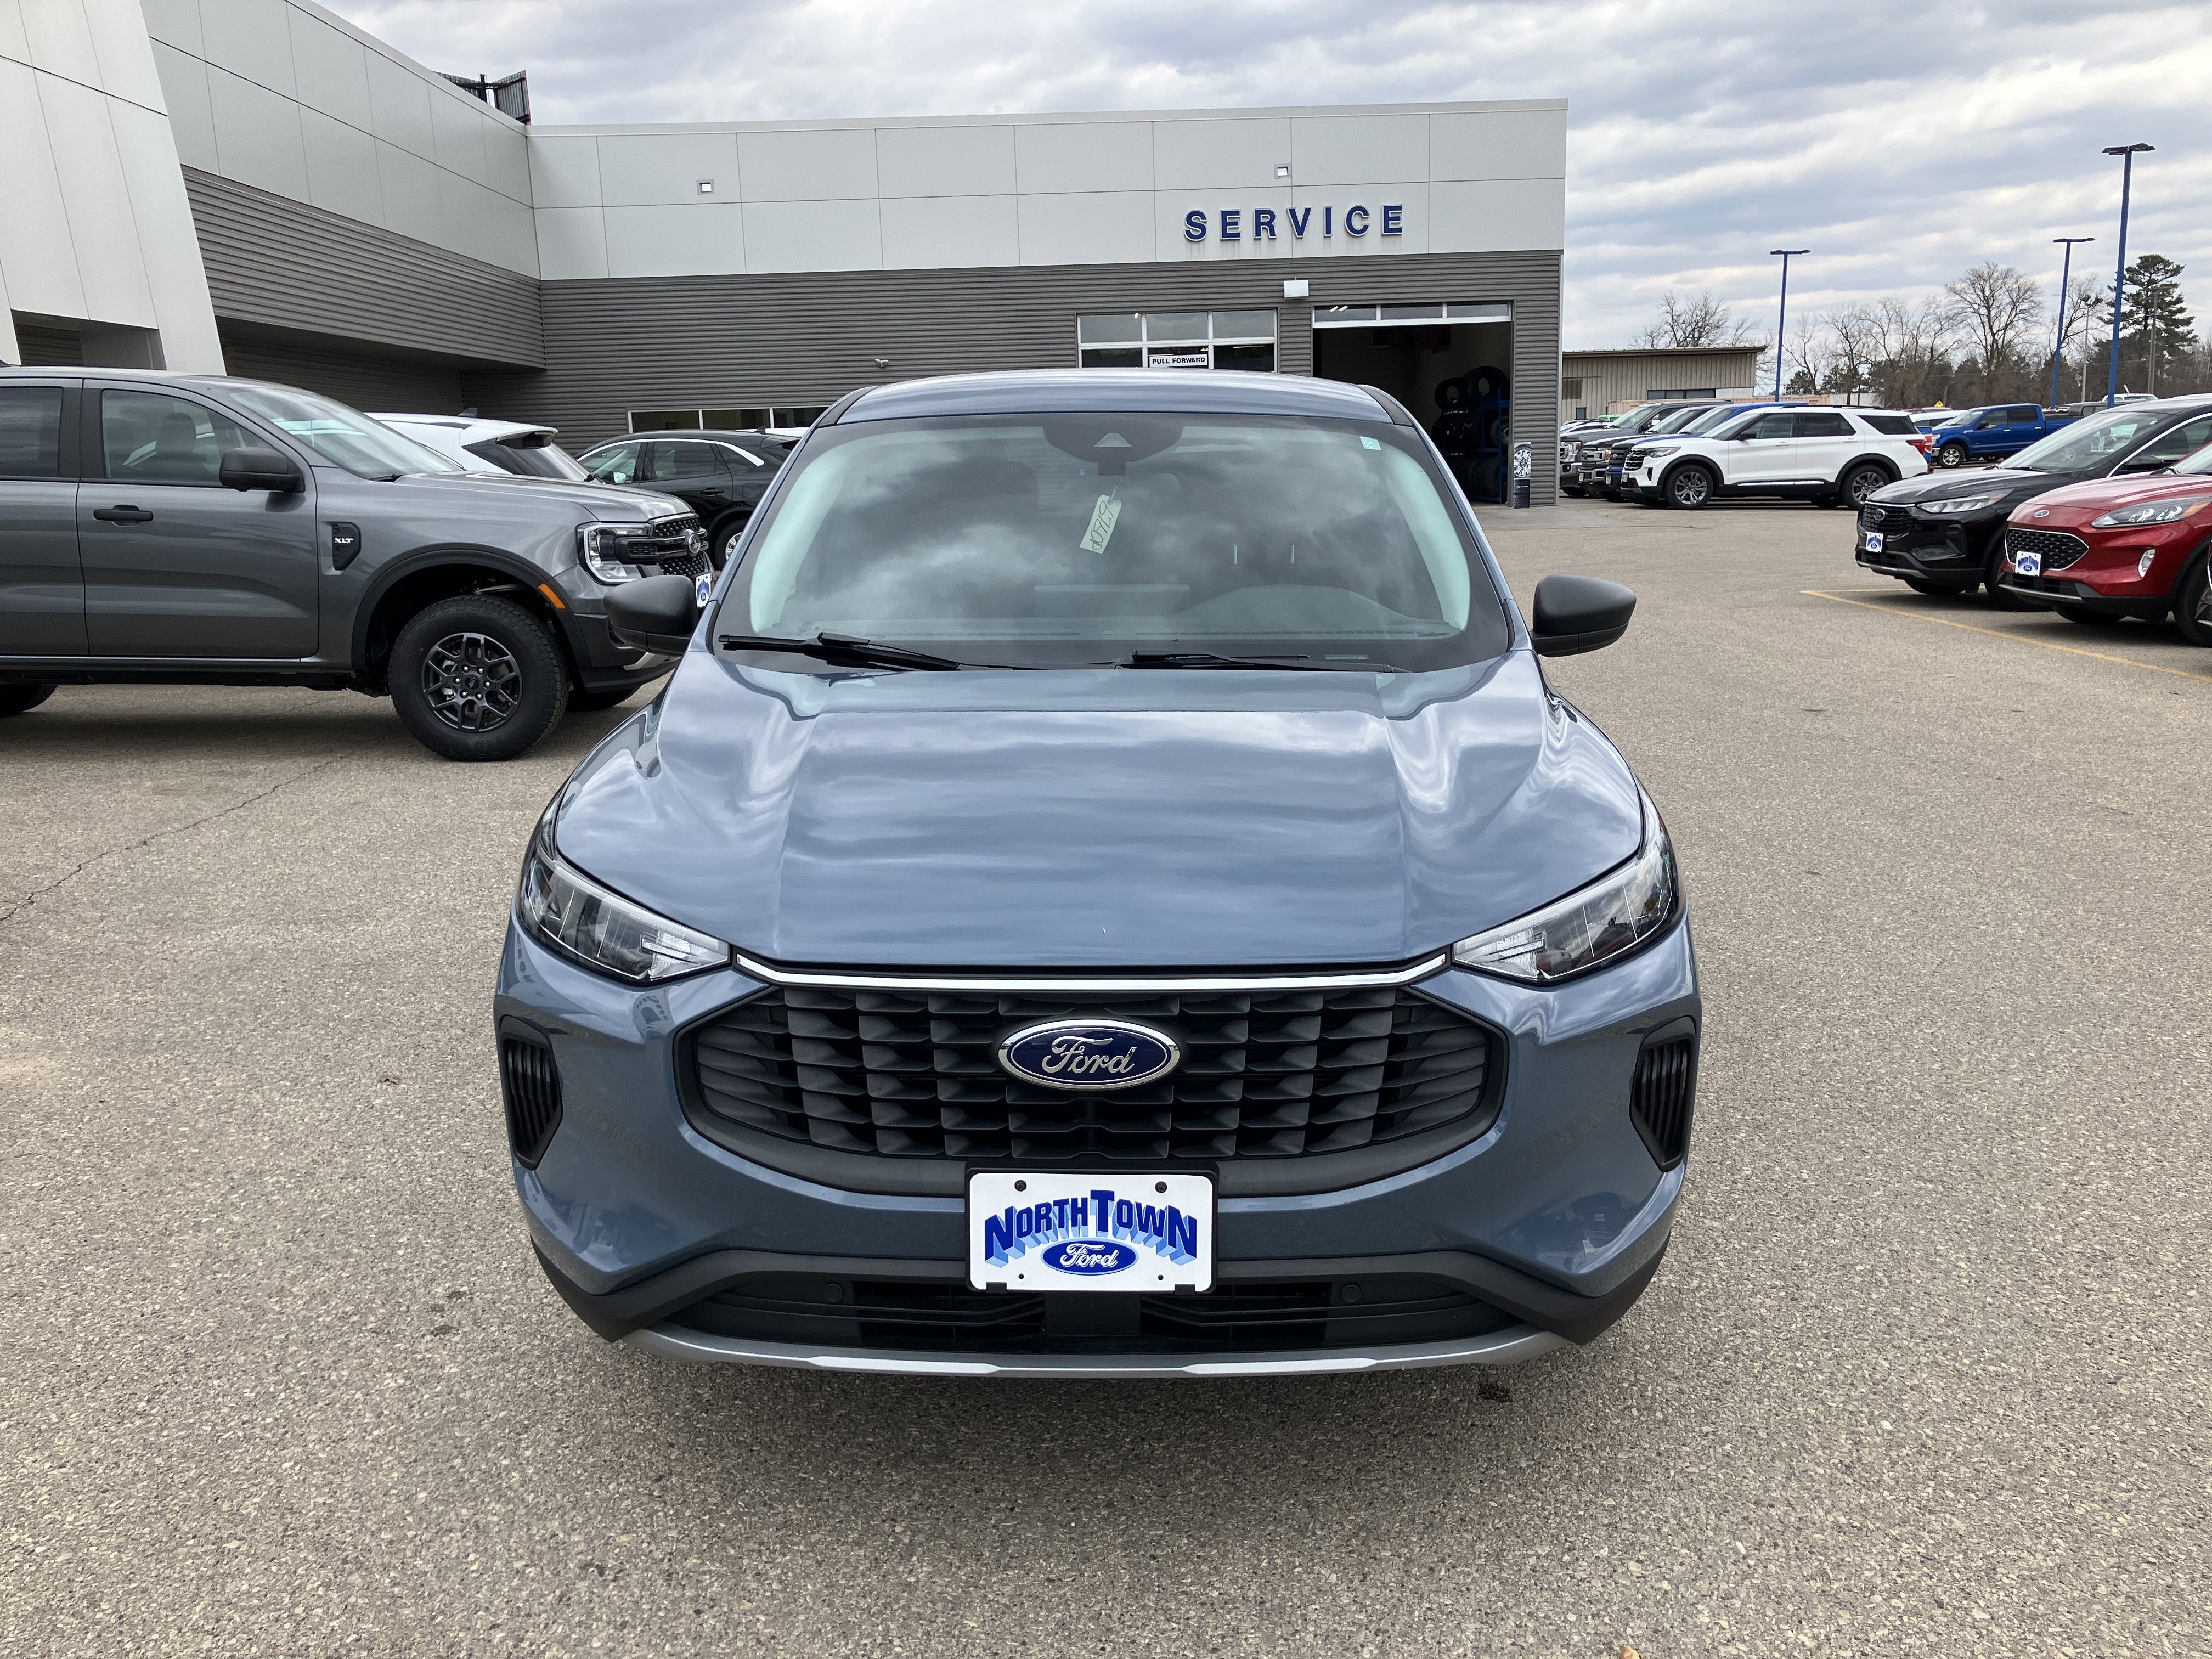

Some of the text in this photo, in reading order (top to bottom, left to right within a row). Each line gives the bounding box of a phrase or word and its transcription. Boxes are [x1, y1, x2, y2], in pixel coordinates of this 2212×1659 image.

[1184, 204, 1403, 241] SERVICE
[1041, 1036, 1137, 1074] Ford
[1059, 1243, 1119, 1268] Ford
